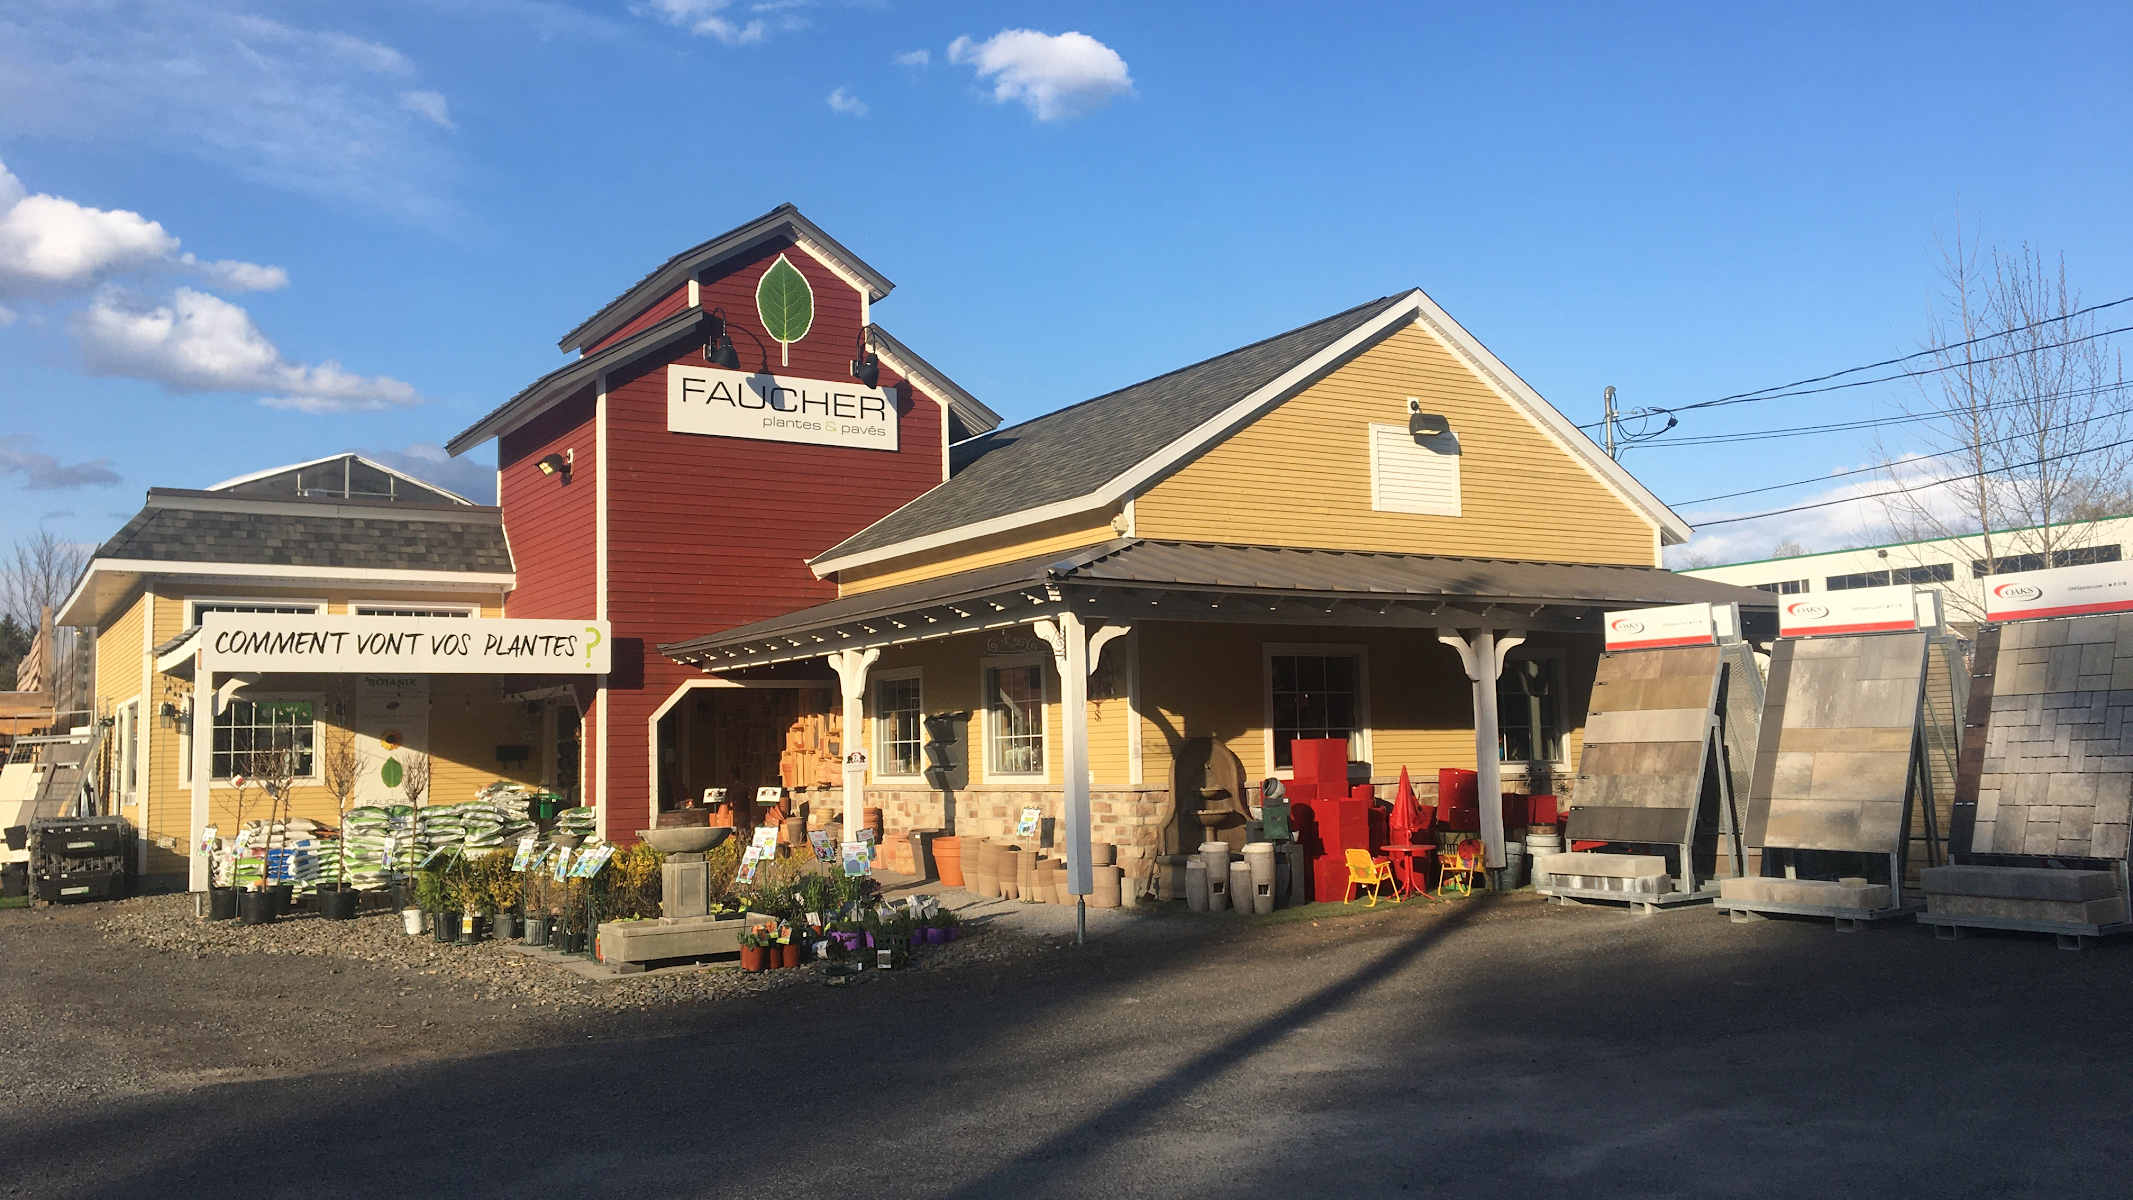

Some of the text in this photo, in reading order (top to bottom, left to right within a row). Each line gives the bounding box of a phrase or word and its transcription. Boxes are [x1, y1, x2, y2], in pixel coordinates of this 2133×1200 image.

[682, 377, 885, 421] FAUCHER
[763, 416, 886, 437] plantes & pavés
[2005, 586, 2034, 595] OAKS
[1797, 605, 1822, 613] OAKS
[215, 631, 350, 656] COMMENT
[357, 633, 424, 657] VONT
[431, 633, 471, 657] VOS
[368, 678, 417, 687] BOTANIX
